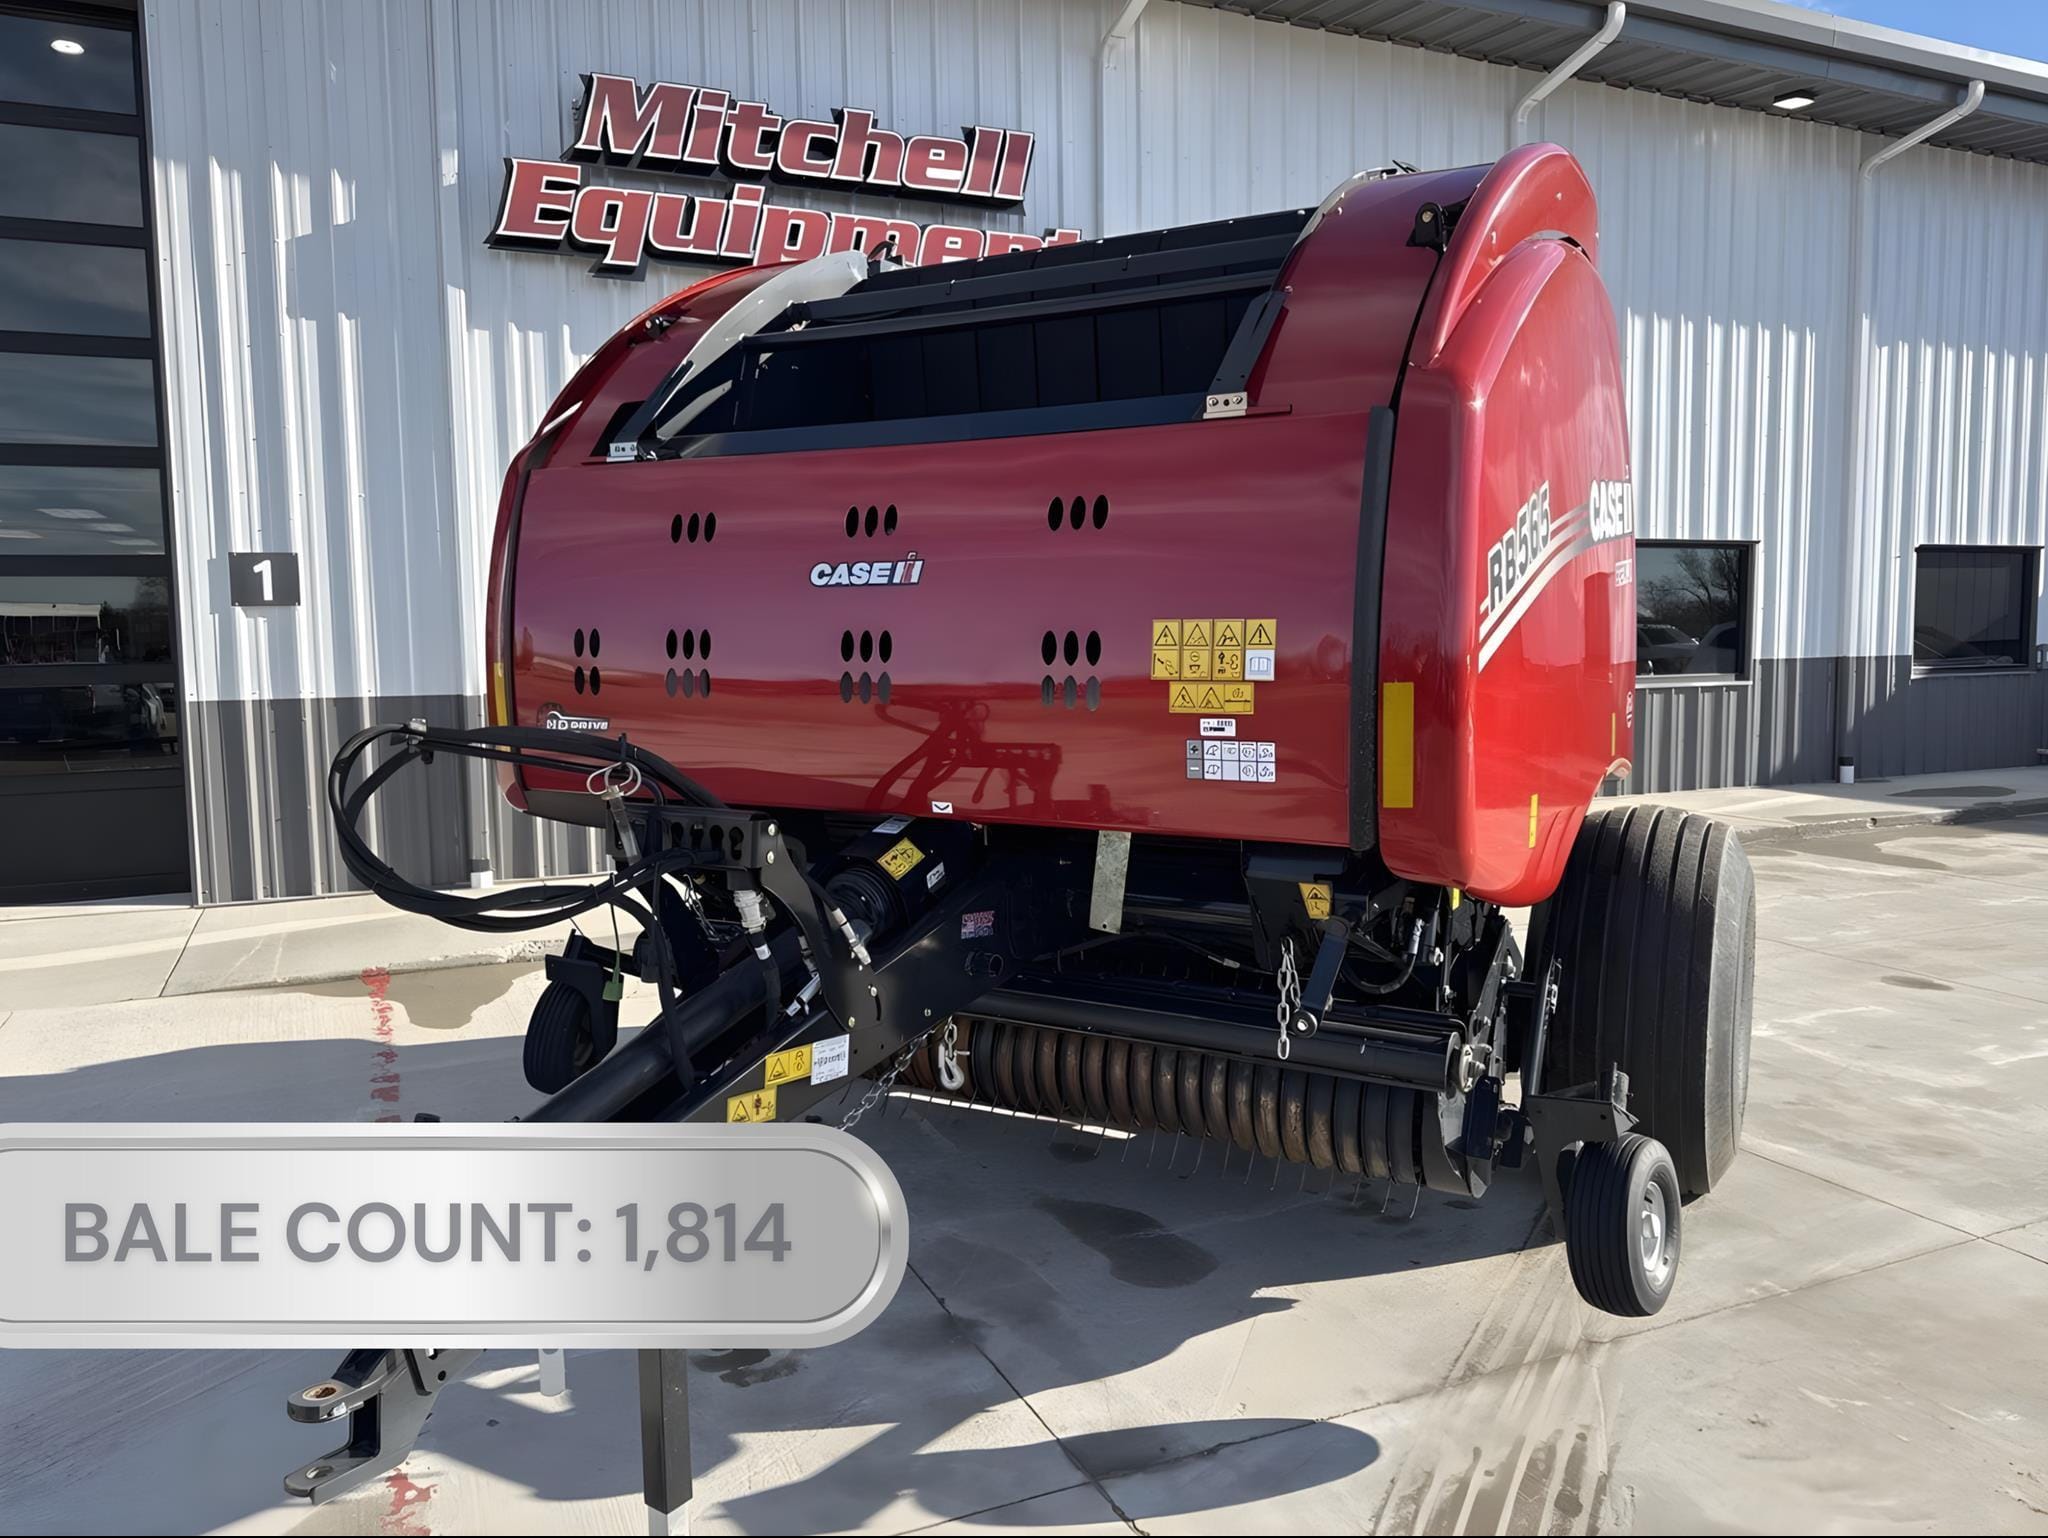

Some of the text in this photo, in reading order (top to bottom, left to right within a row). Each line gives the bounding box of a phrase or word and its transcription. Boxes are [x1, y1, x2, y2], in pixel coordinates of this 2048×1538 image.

[576, 72, 1034, 201] Mitchell
[496, 157, 1082, 267] Equipme
[1590, 480, 1622, 542] CASE
[253, 560, 273, 601] 1
[810, 561, 893, 586] CASE
